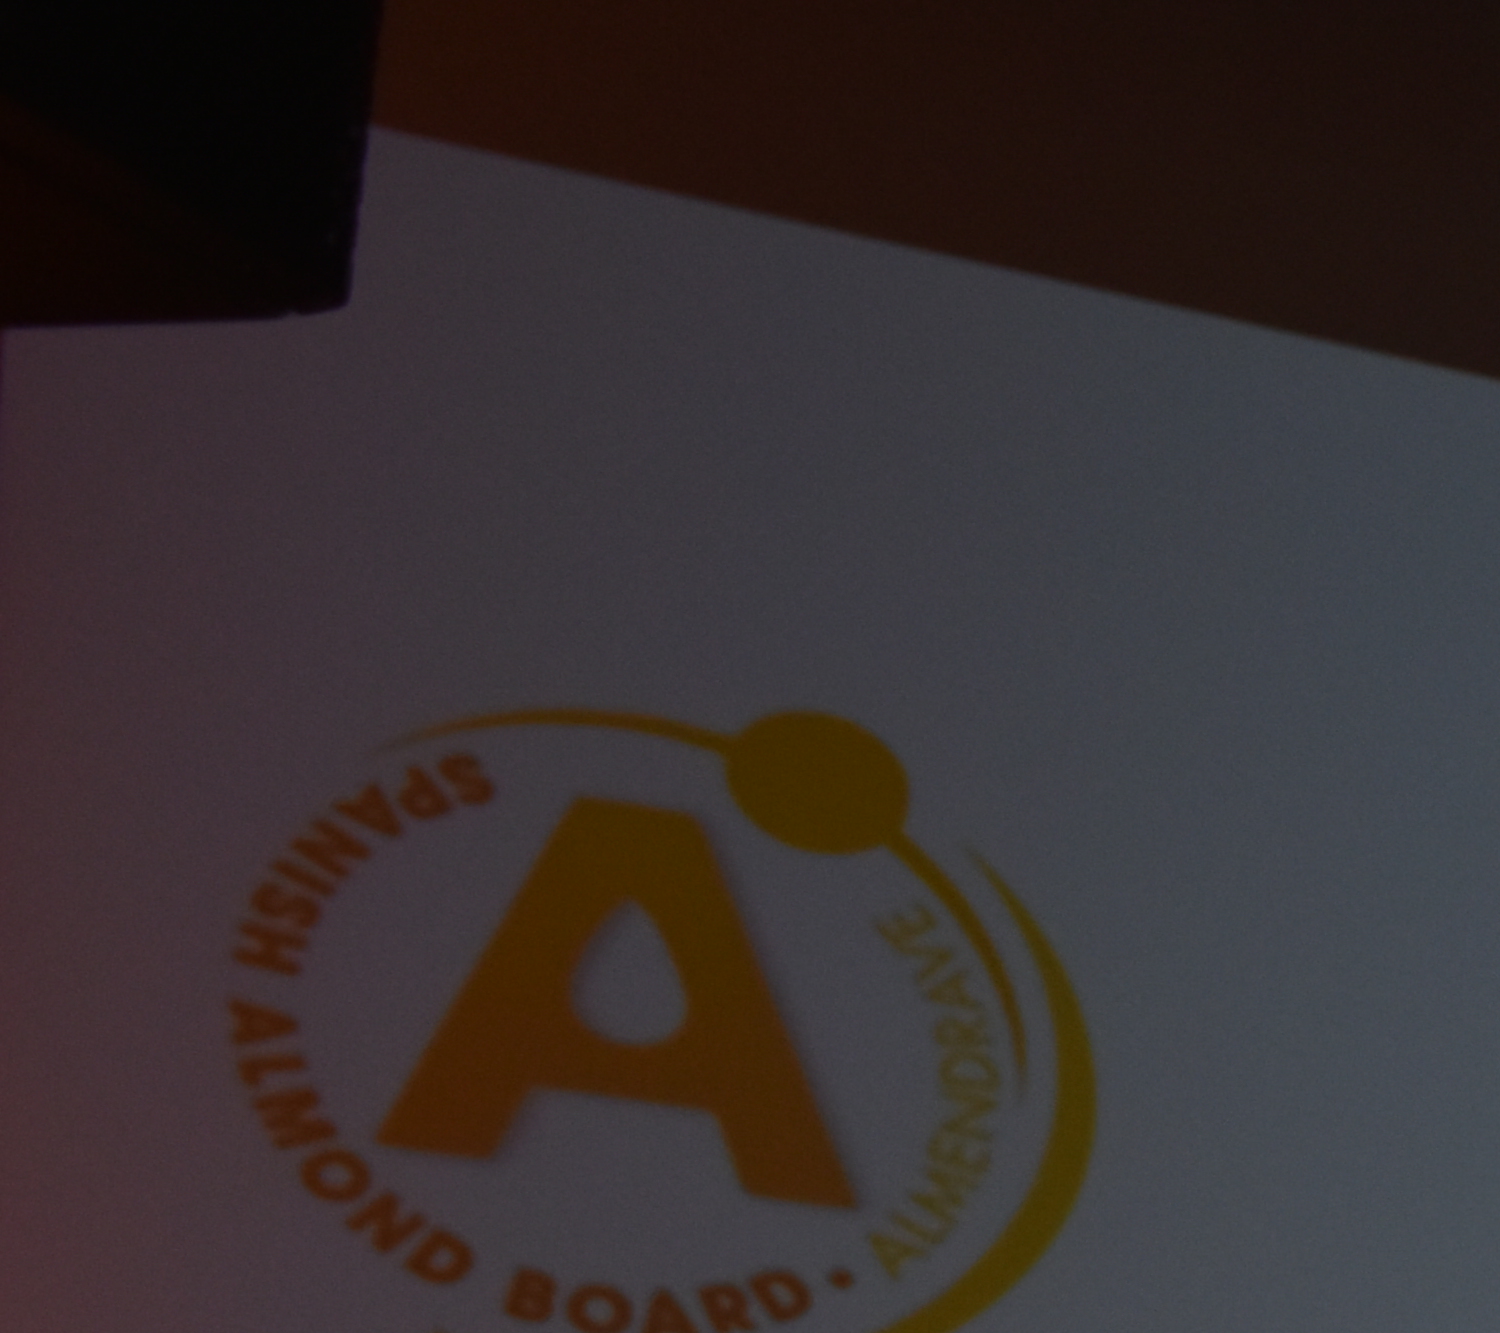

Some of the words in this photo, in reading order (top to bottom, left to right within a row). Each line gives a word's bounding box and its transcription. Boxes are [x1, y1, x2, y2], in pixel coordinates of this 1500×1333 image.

[231, 753, 496, 977] SPANISH
[228, 999, 476, 1289] ALMOND
[867, 902, 998, 1280] ALMENDRAVE
